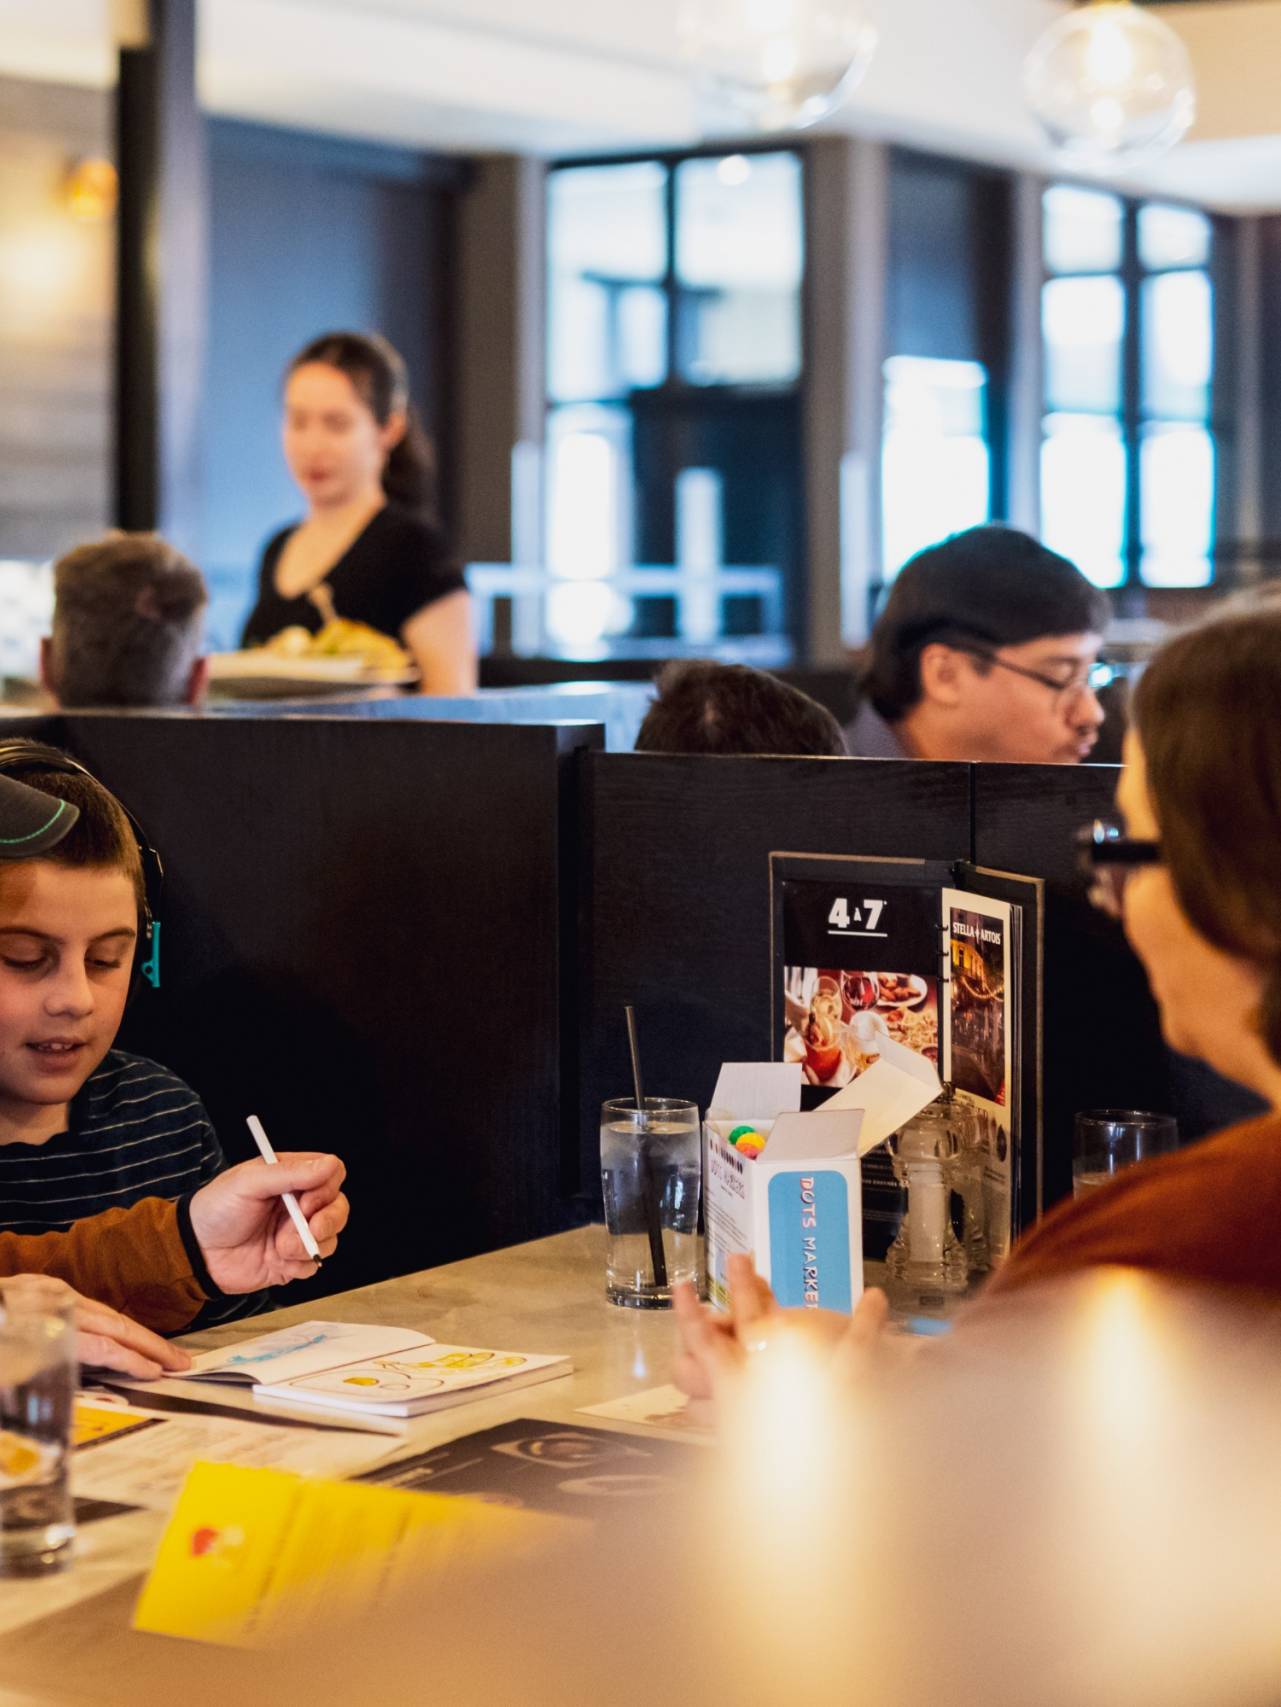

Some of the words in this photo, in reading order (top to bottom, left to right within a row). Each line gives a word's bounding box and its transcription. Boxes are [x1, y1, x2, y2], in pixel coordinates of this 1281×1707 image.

[953, 921, 975, 937] STELLA
[980, 929, 1001, 945] ARTOIS
[800, 1177, 817, 1228] DOTS
